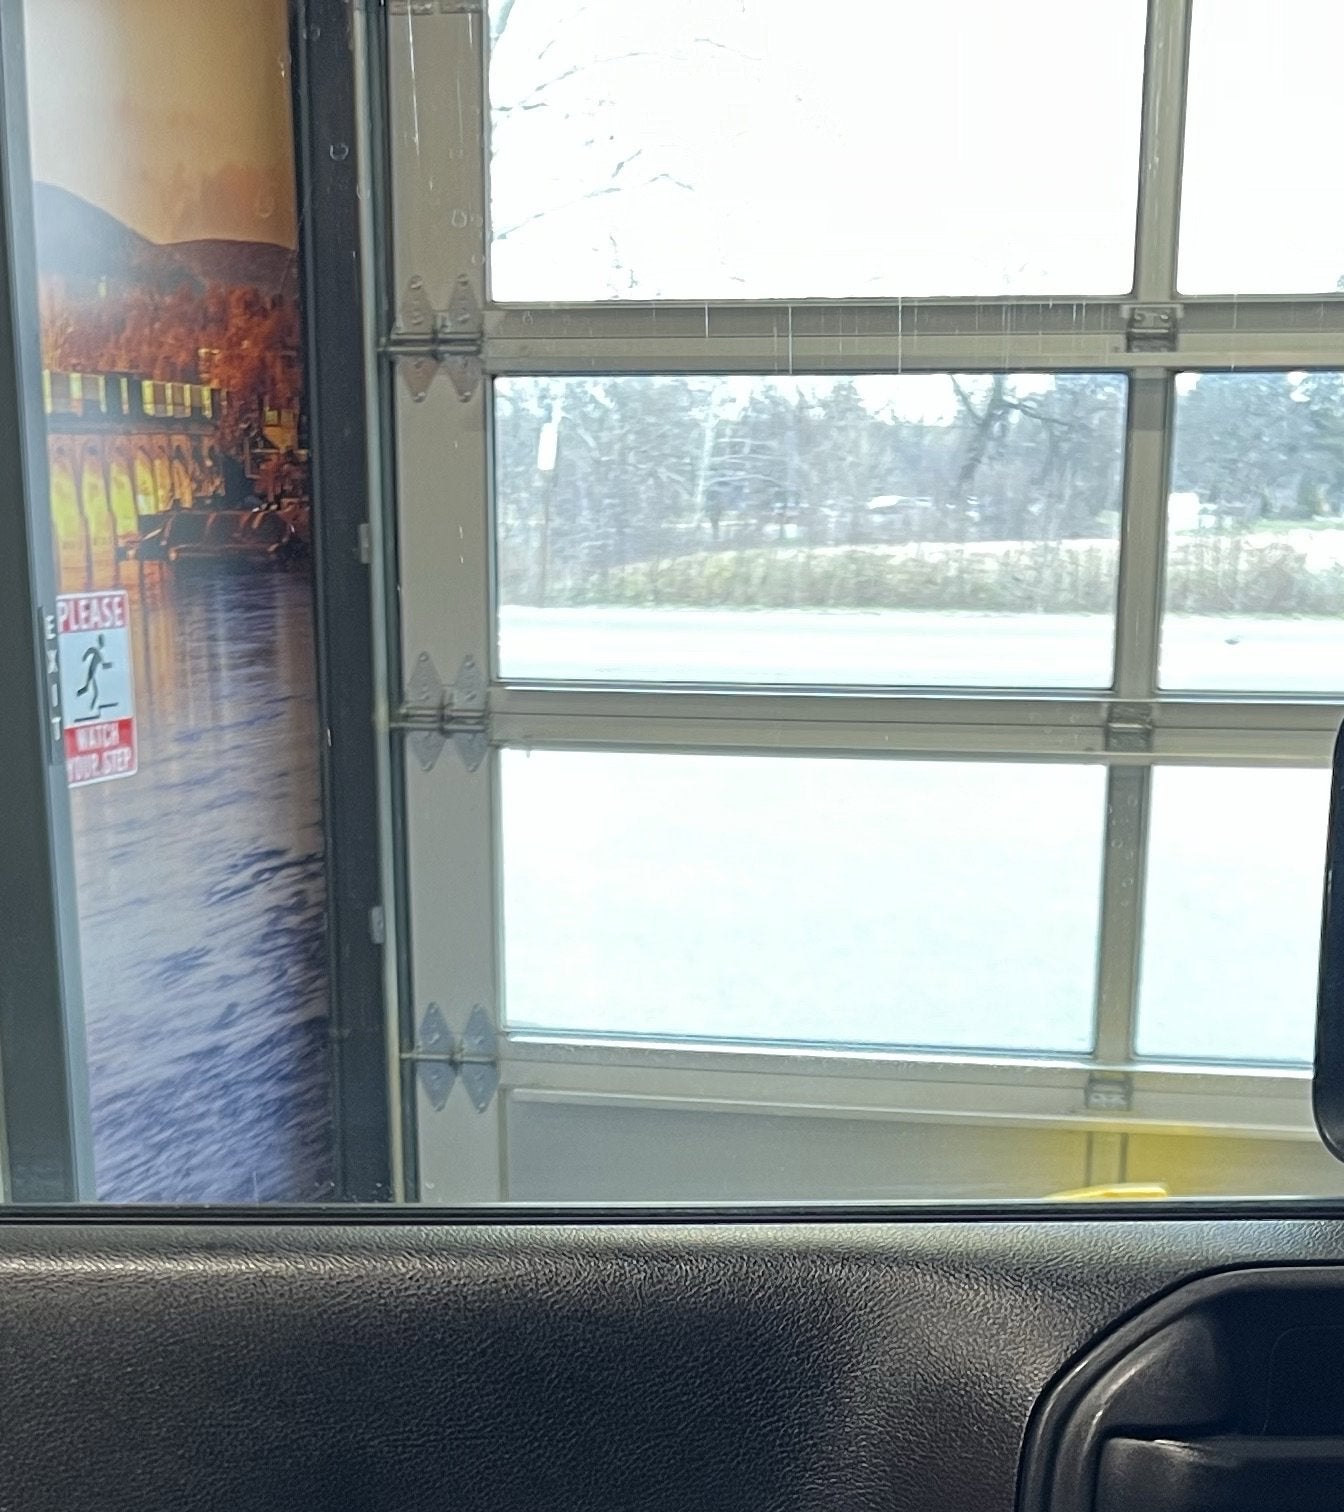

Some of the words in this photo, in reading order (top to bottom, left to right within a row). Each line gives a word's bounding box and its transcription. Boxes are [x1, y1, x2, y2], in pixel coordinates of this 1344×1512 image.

[57, 597, 124, 632] PLEASE
[45, 615, 61, 740] EXIT
[75, 722, 120, 752] WATCH
[102, 749, 131, 773] STEP
